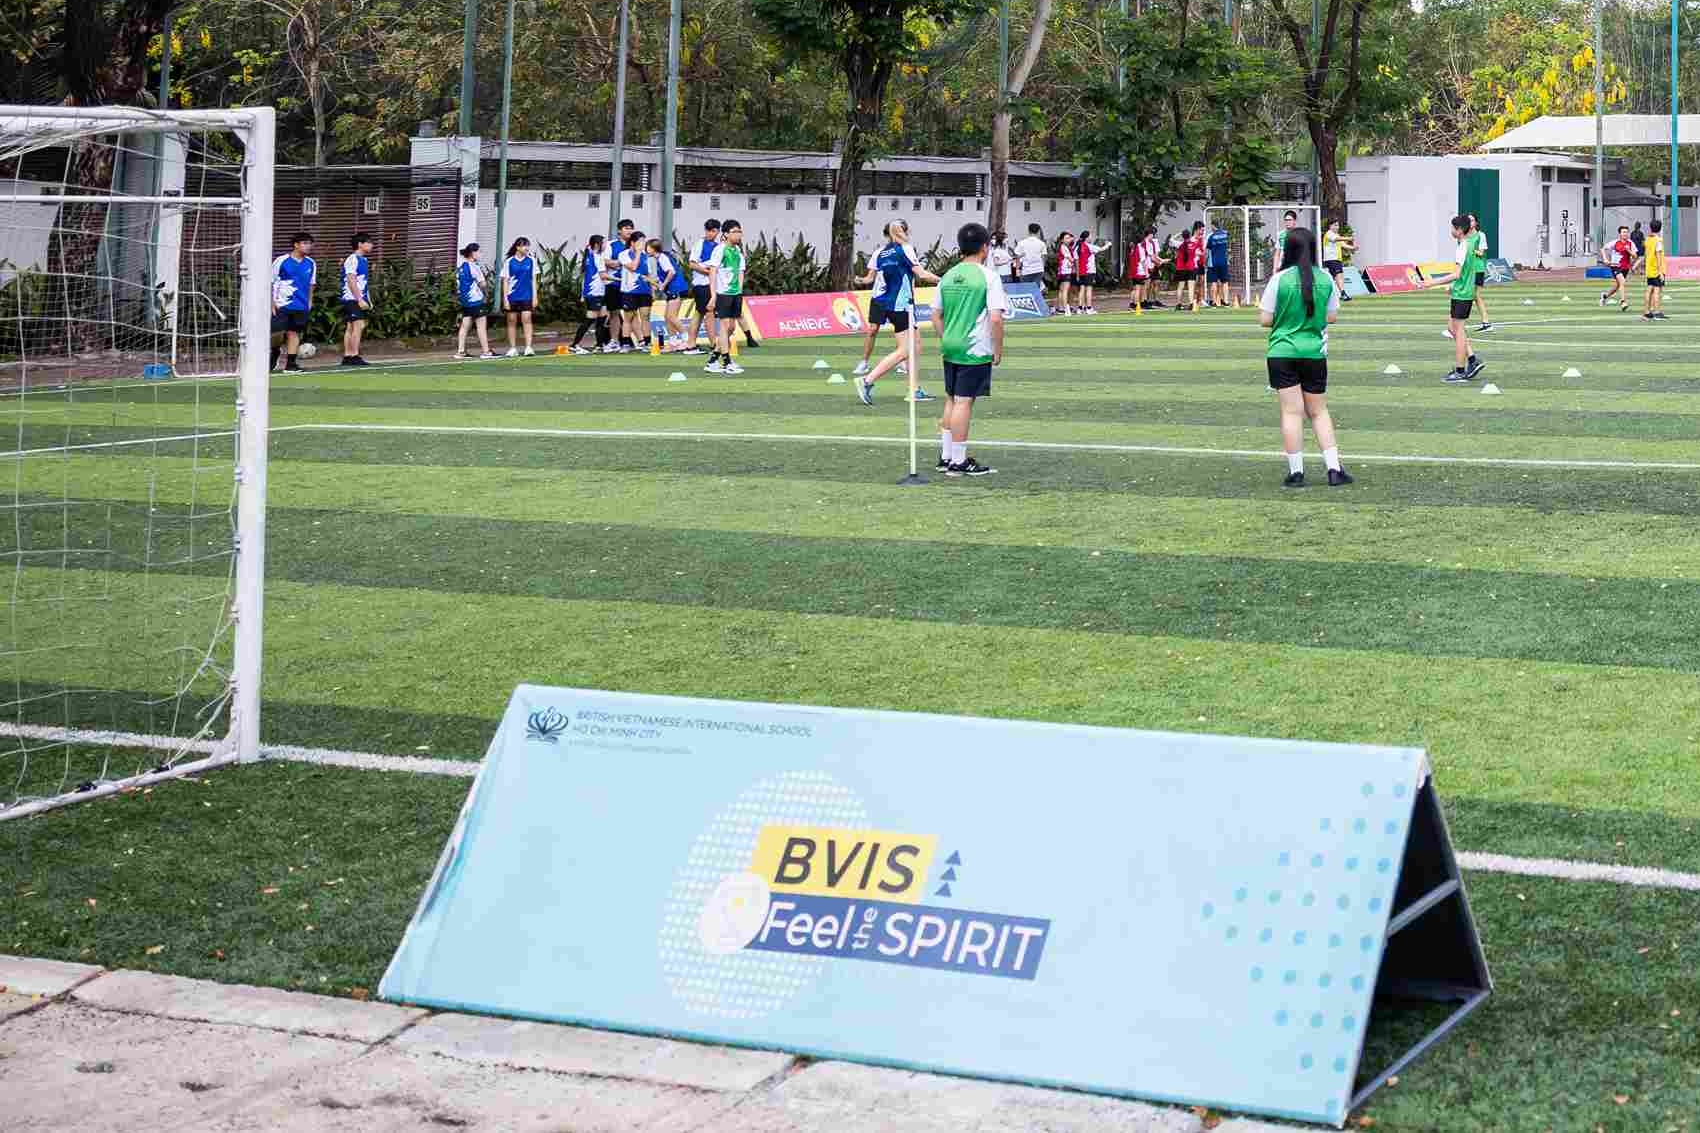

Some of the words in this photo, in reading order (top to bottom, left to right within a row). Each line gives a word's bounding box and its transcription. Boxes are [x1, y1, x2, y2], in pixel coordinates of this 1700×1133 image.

[576, 710, 615, 724] BRITISH
[616, 713, 681, 728] VIETNAMESE
[684, 718, 767, 735] INTERNATIONAL
[769, 725, 812, 738] SCHOOL
[610, 728, 637, 738] MINH
[638, 729, 663, 739] CITY
[774, 836, 920, 894] BVIS
[760, 900, 856, 950] Feel
[852, 906, 879, 950] the
[877, 911, 1044, 972] SPIRIT
